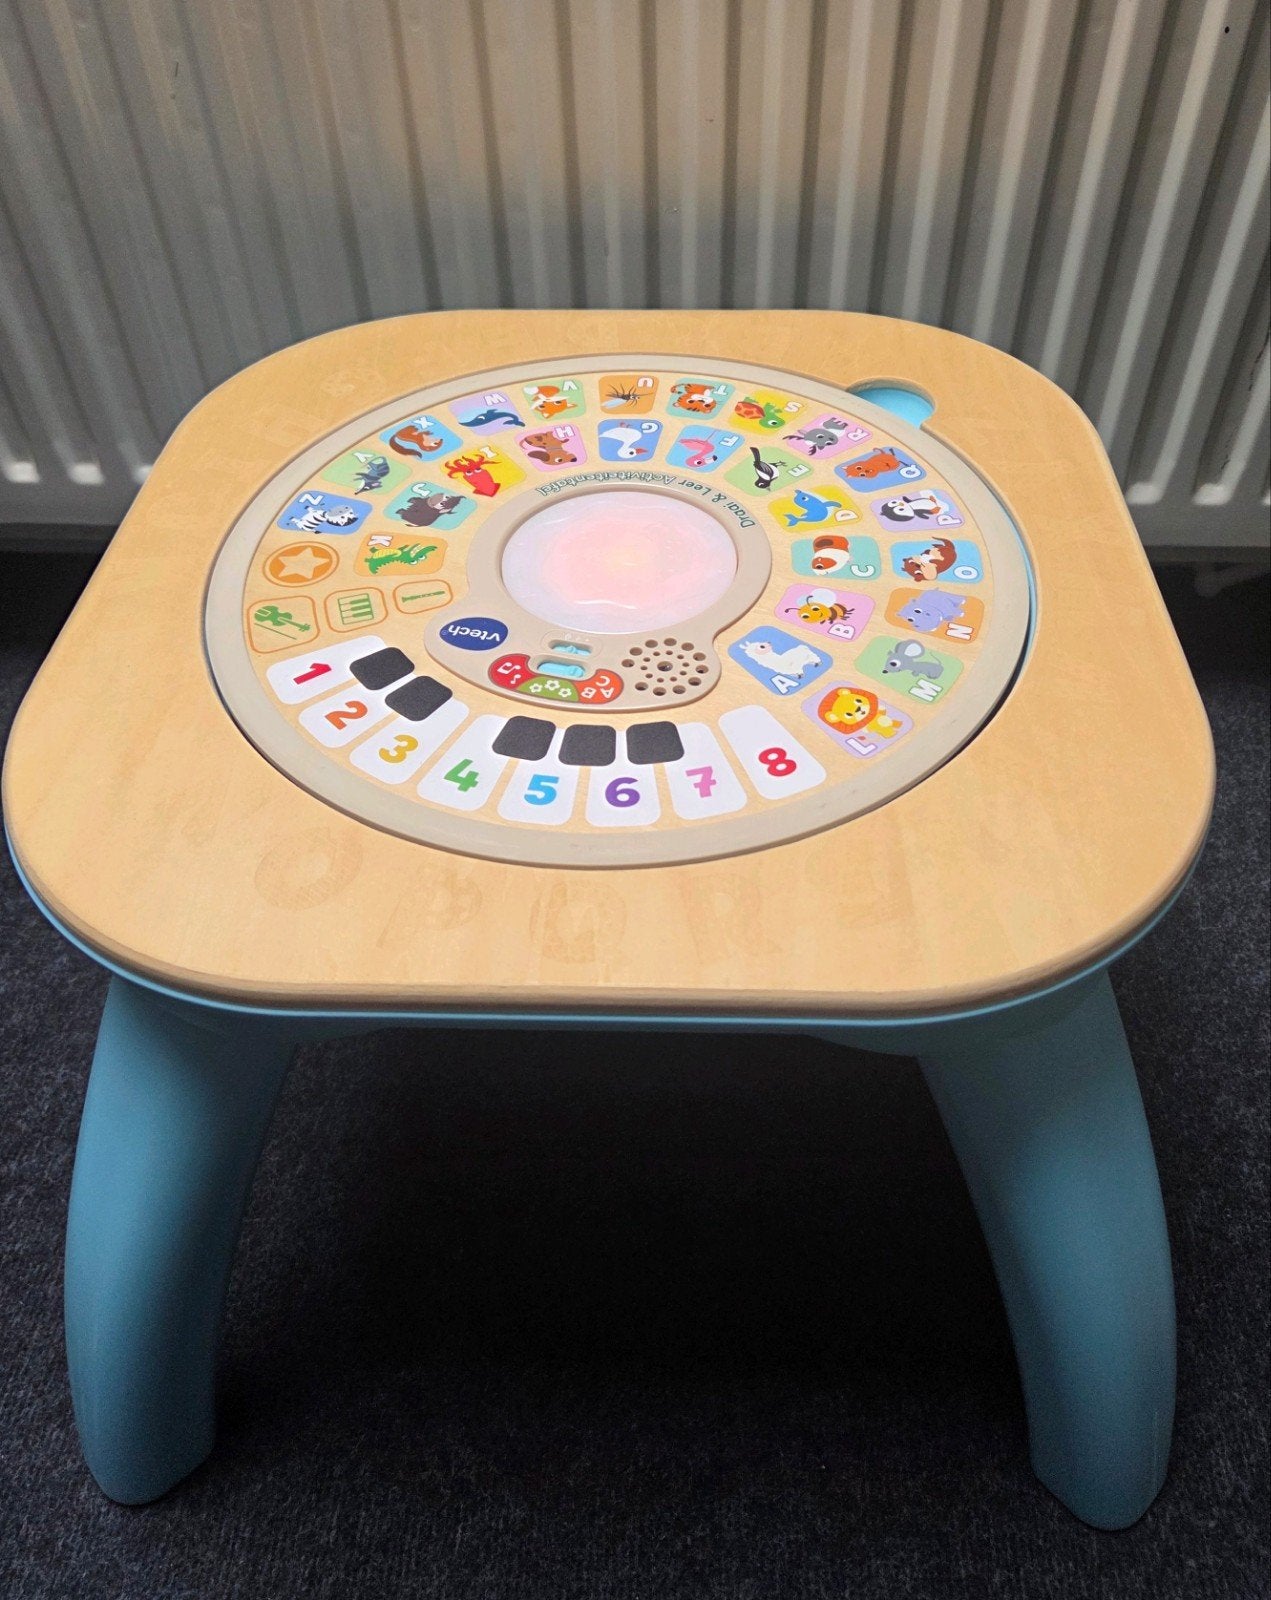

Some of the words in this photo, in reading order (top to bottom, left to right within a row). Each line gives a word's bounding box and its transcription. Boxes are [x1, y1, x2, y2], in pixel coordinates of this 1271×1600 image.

[562, 380, 578, 392] V
[637, 377, 654, 388] U
[713, 384, 730, 396] T
[484, 392, 507, 406] W
[784, 401, 804, 413] S
[412, 414, 434, 430] X
[640, 422, 660, 434] G
[554, 425, 575, 439] H
[846, 427, 870, 442] R
[720, 434, 740, 448] F
[352, 451, 374, 464] Y
[787, 464, 811, 478] E
[899, 464, 923, 480] Q
[410, 482, 431, 497] J
[678, 480, 712, 496] Leer
[299, 492, 324, 506] Z
[712, 493, 727, 502] &
[722, 502, 756, 528] Draai
[834, 508, 859, 522] D
[936, 514, 962, 526] P
[367, 534, 394, 548] K
[850, 564, 876, 579] C
[952, 565, 979, 580] O
[827, 623, 855, 640] B
[945, 622, 974, 641] N
[292, 662, 332, 686] 1
[770, 673, 801, 695] A
[908, 677, 944, 702] M
[324, 700, 369, 731] 2
[378, 734, 419, 764] 3
[845, 736, 878, 756] L
[758, 746, 798, 778] 8
[444, 758, 480, 793] 4
[684, 766, 717, 798] 7
[523, 774, 560, 806] 5
[604, 776, 641, 808] 6
